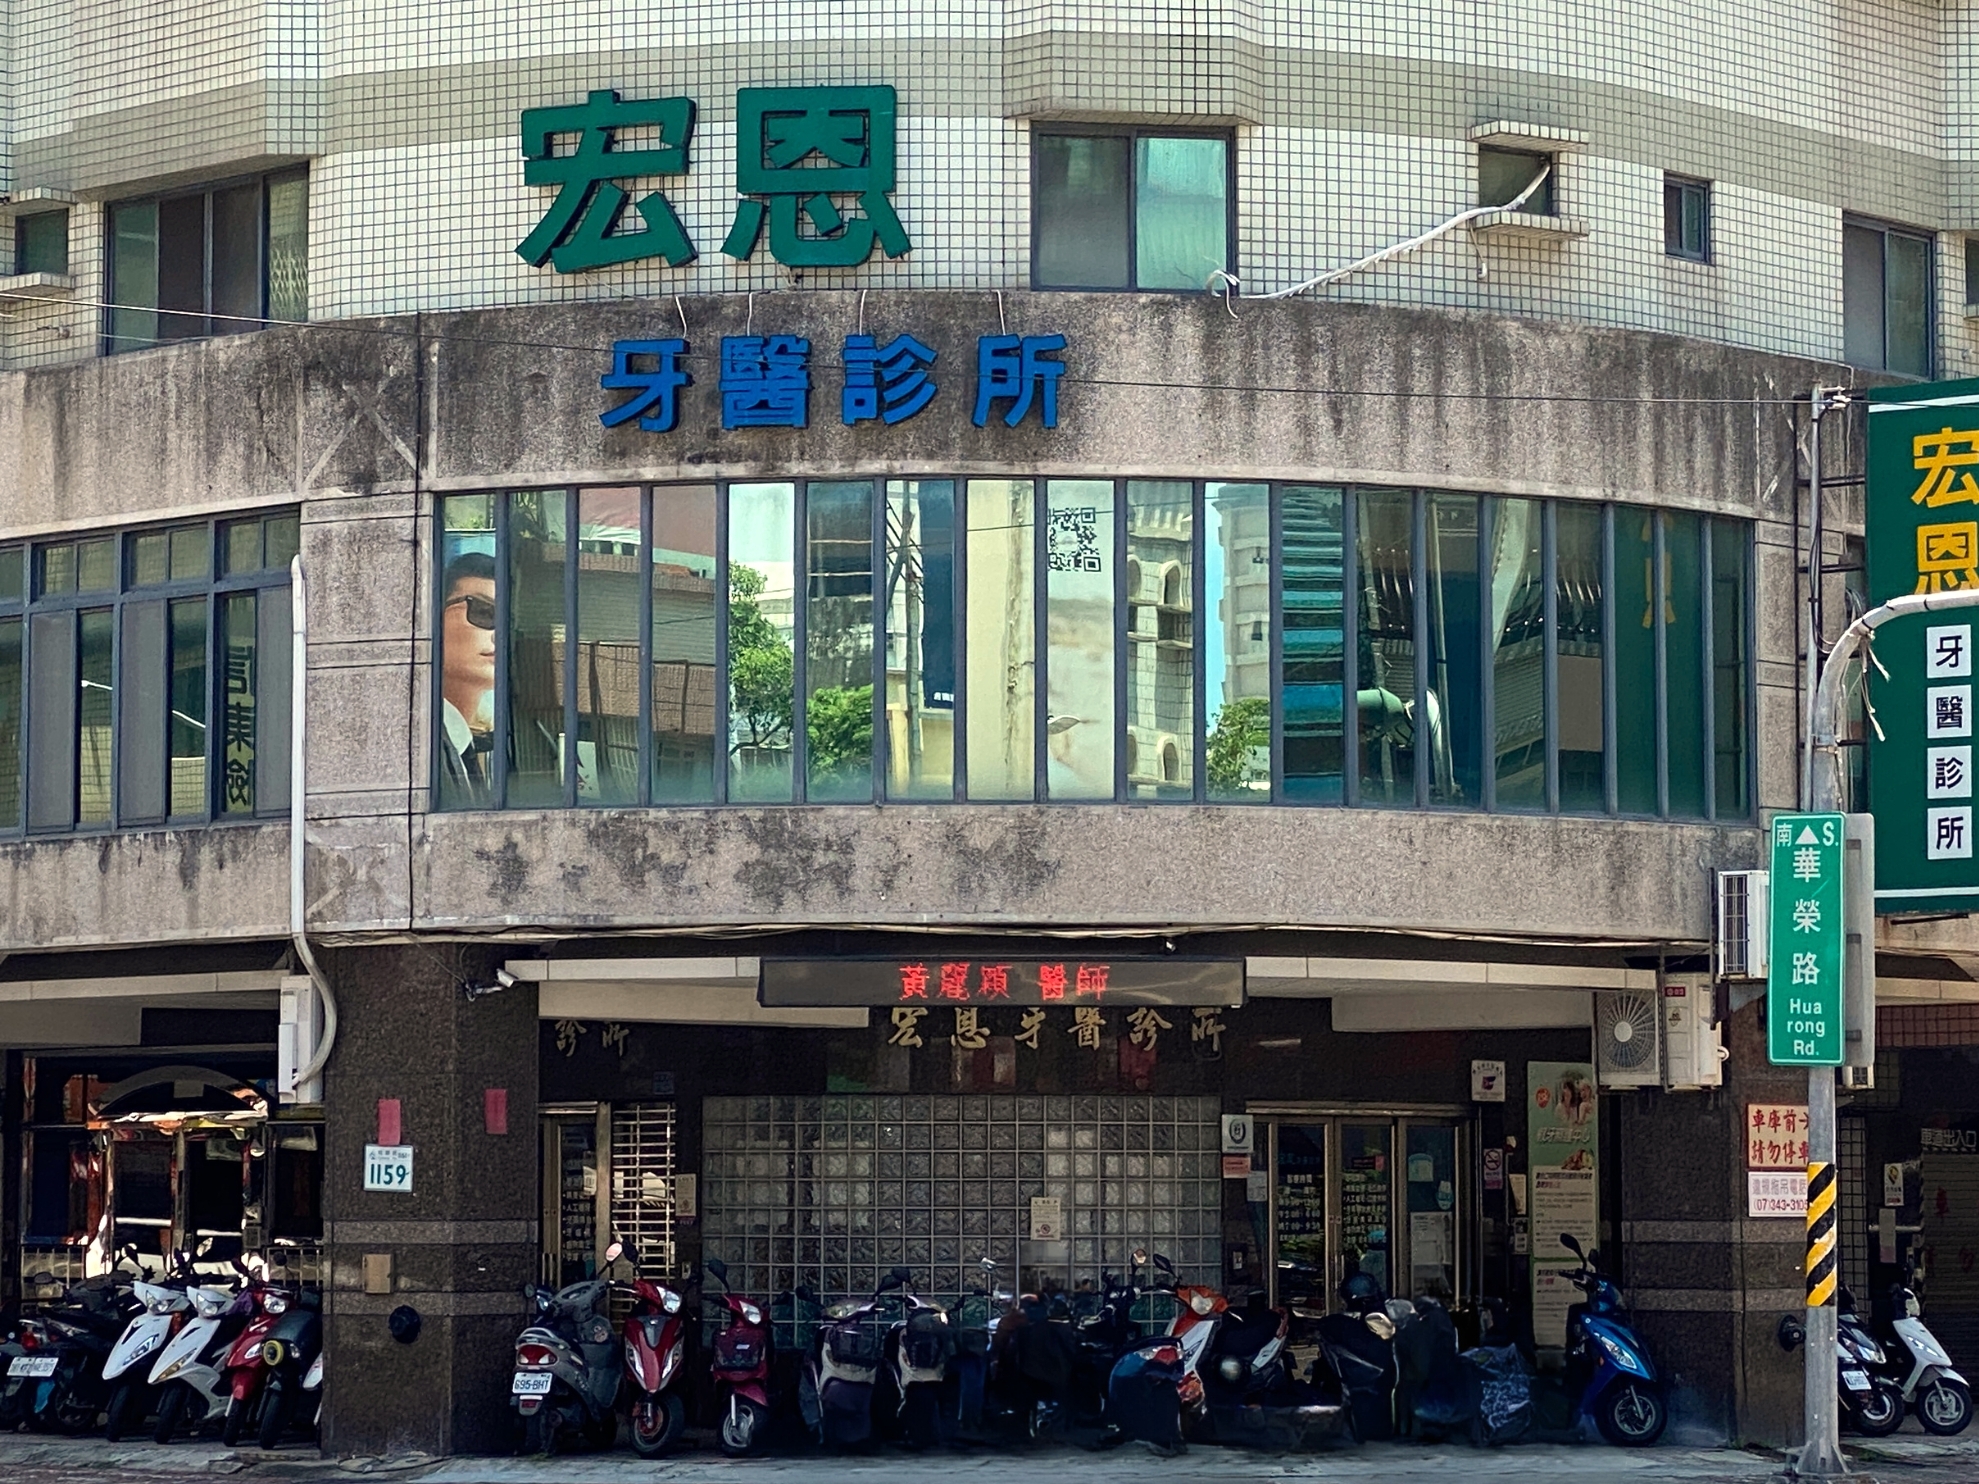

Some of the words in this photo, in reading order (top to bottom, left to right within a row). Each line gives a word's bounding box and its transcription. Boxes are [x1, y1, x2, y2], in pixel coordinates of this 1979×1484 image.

[516, 85, 912, 273] 宏恩
[599, 333, 1067, 432] 牙醫診所
[1912, 427, 1979, 595] 宏恩
[1935, 635, 1964, 850] 牙醫診所
[1777, 823, 1793, 848] 南
[1822, 821, 1838, 846] S.
[1792, 847, 1821, 985] 華榮路
[1037, 963, 1110, 1001] 醫師
[1789, 998, 1822, 1015] Hua
[1787, 1021, 1826, 1037] rong
[1793, 1040, 1820, 1056] Rd.
[1752, 1109, 1797, 1133] 車庫前
[1752, 1140, 1809, 1164] 請勿停車
[370, 1163, 406, 1186] 1159
